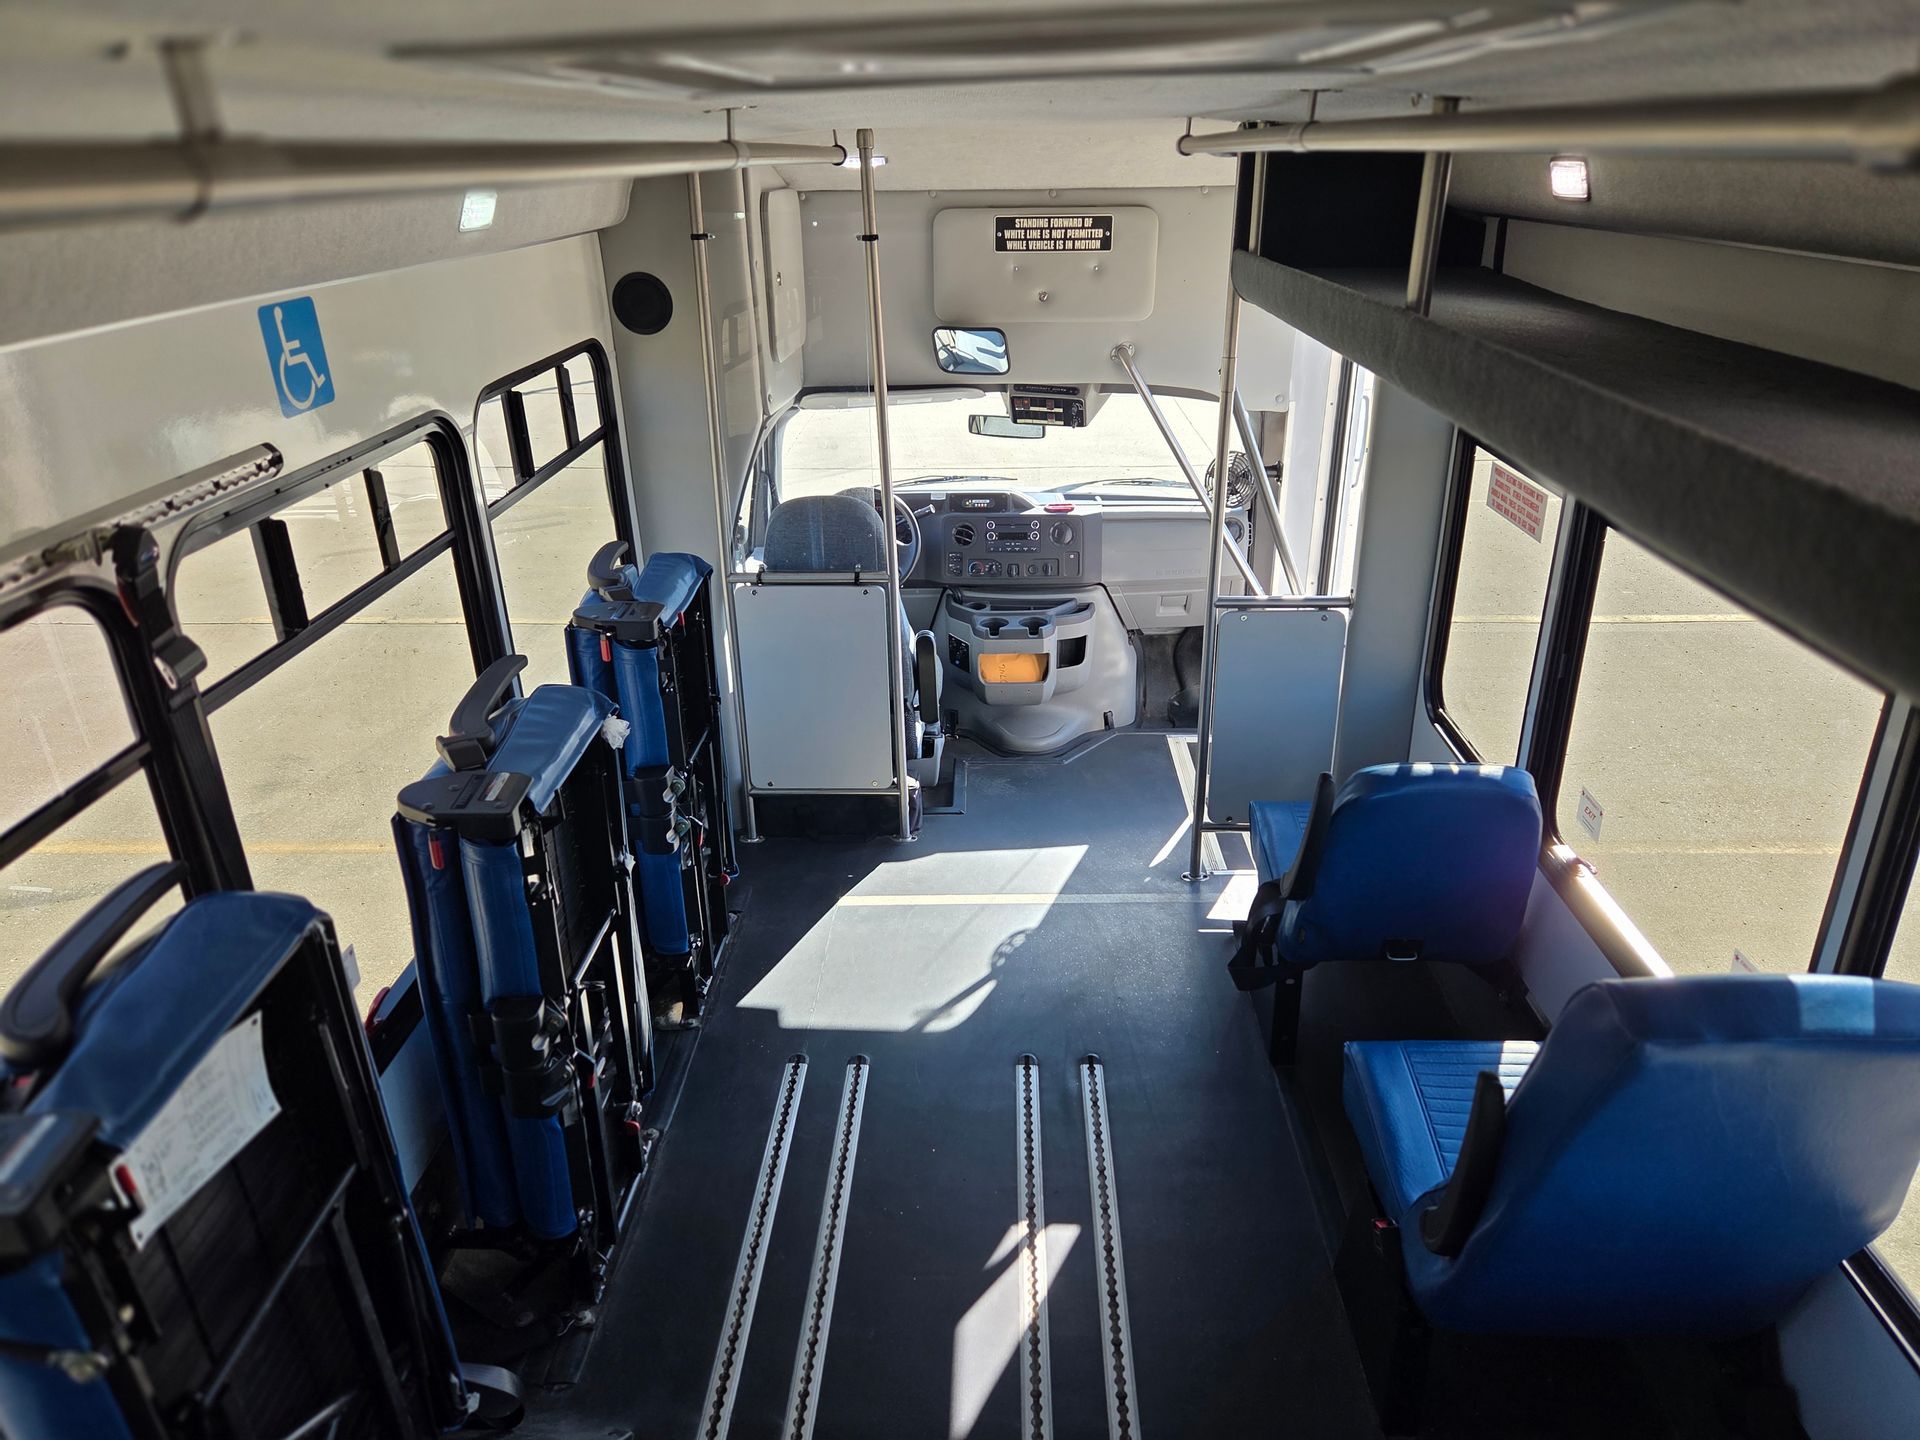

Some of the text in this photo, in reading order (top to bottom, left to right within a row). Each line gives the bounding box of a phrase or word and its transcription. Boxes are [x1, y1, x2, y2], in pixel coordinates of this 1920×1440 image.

[1015, 218, 1092, 228] STANDING FORWARD OF
[1004, 229, 1103, 239] WHITE LINE IS NOT PERMITTED
[1007, 240, 1100, 250] WHILE VEHICLE IS IN MOTION
[1584, 806, 1596, 820] EXIT
